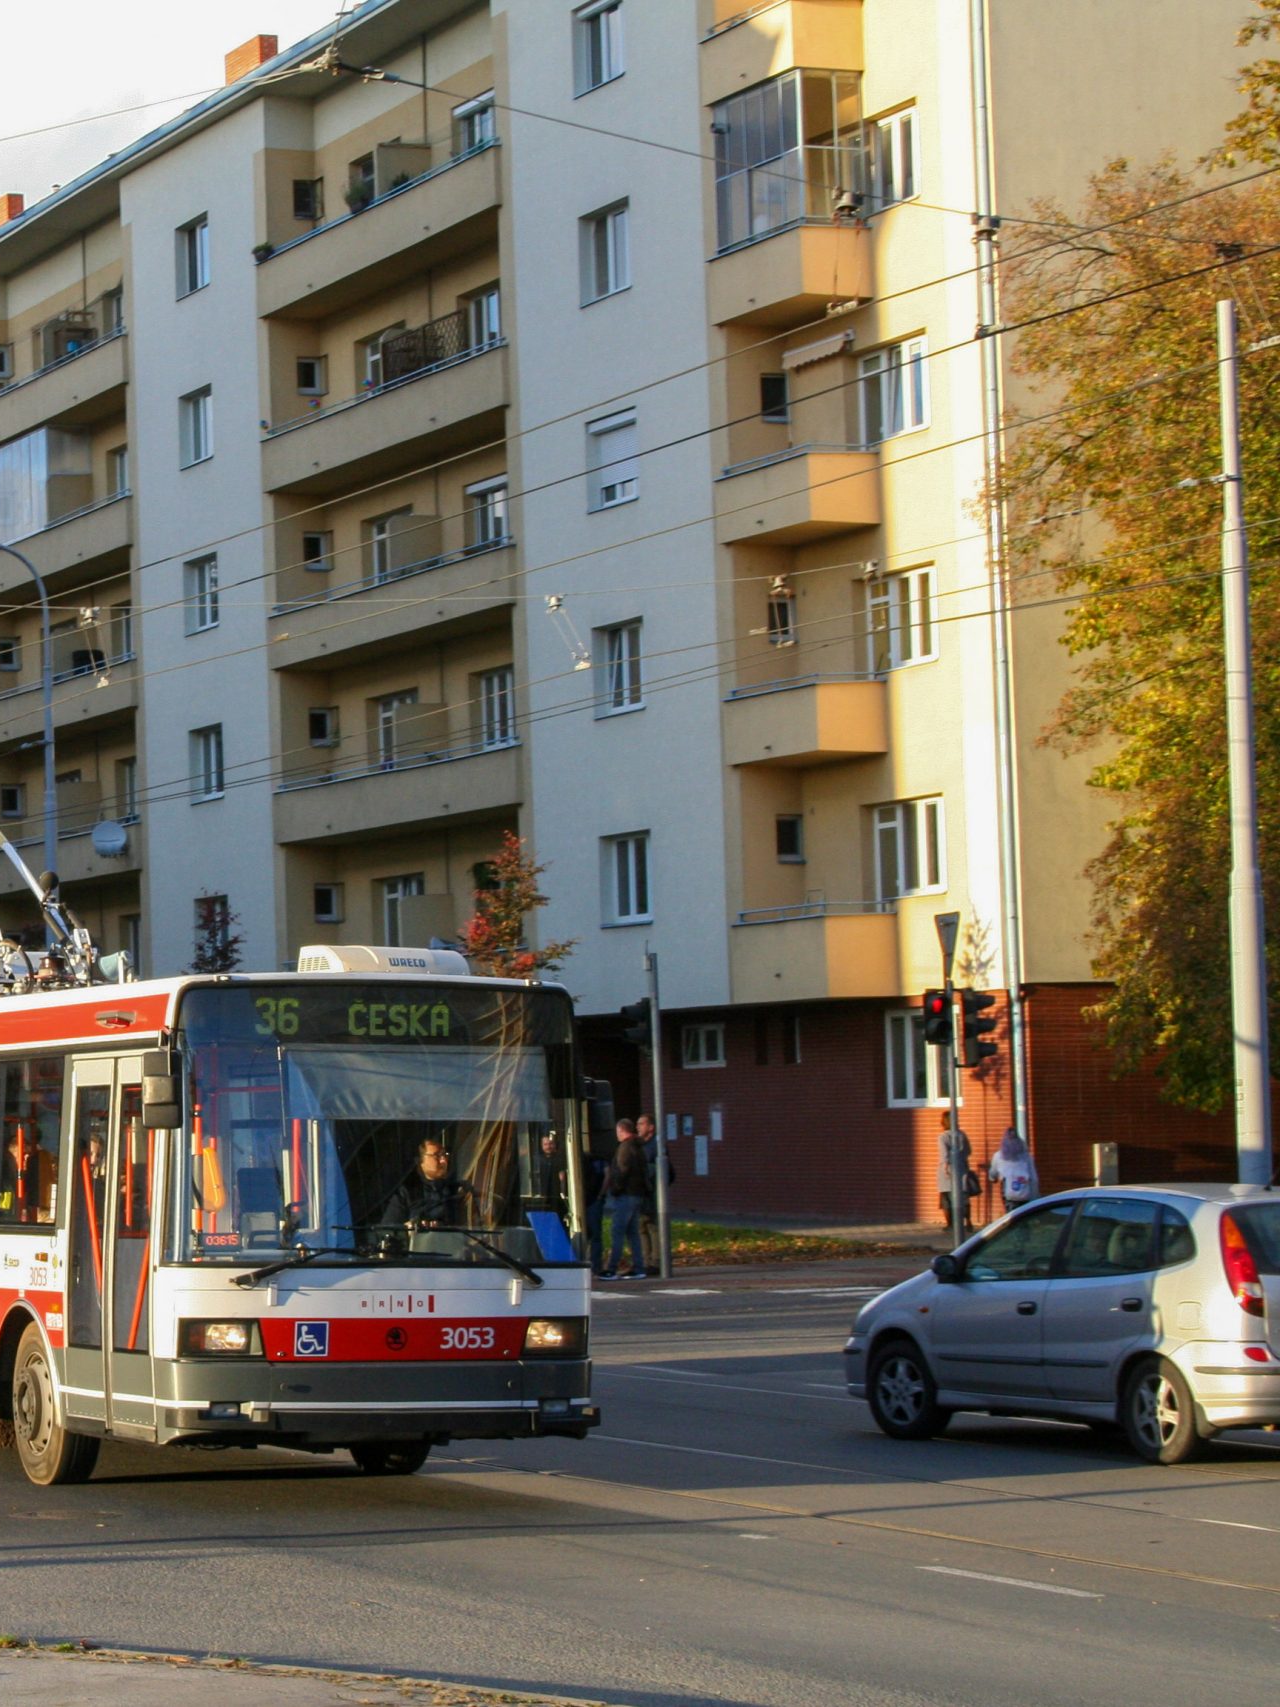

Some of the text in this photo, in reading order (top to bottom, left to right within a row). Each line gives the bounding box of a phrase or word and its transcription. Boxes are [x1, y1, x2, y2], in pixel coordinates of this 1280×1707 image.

[254, 997, 451, 1038] 36 ČESKÁ
[29, 1267, 48, 1287] 3053
[439, 1326, 495, 1350] 3053
